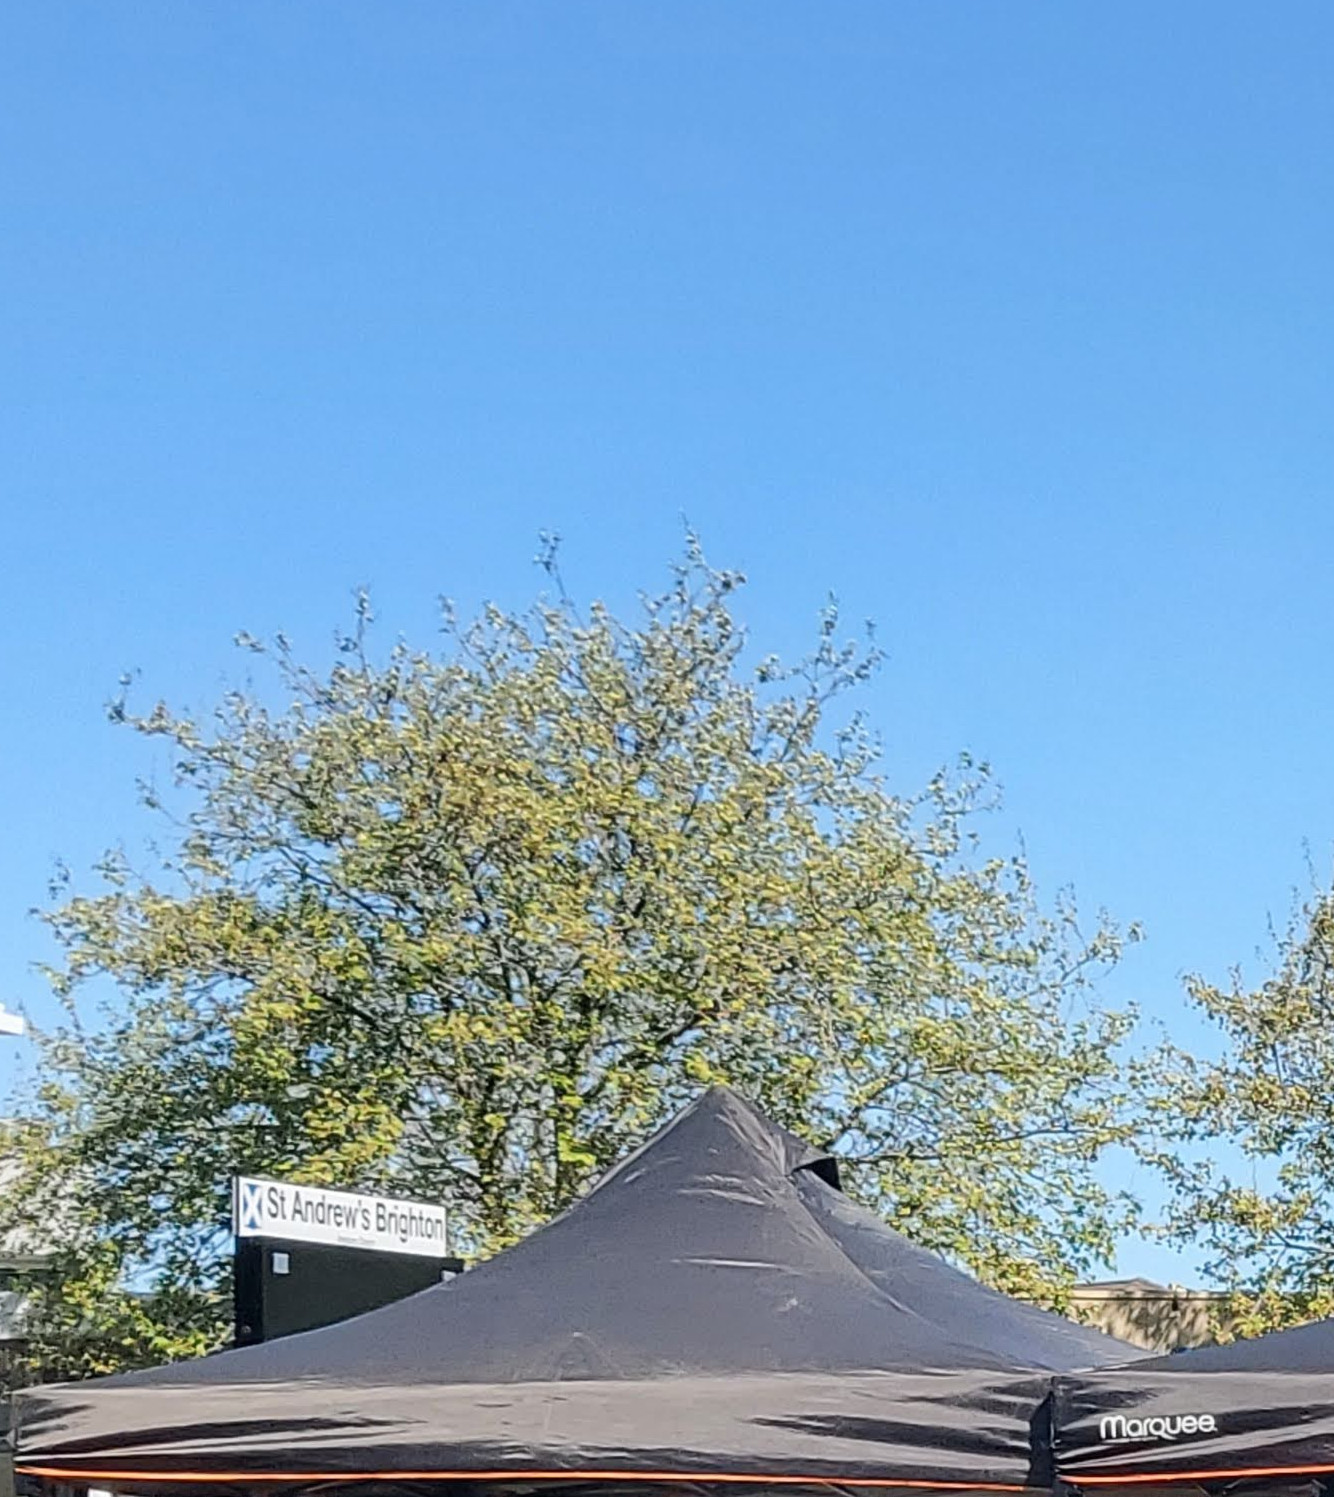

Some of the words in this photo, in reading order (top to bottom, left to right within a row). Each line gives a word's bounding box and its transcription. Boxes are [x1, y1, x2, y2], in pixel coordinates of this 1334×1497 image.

[267, 1186, 287, 1221] St
[290, 1191, 371, 1231] Andrew's
[376, 1203, 444, 1244] Brighton
